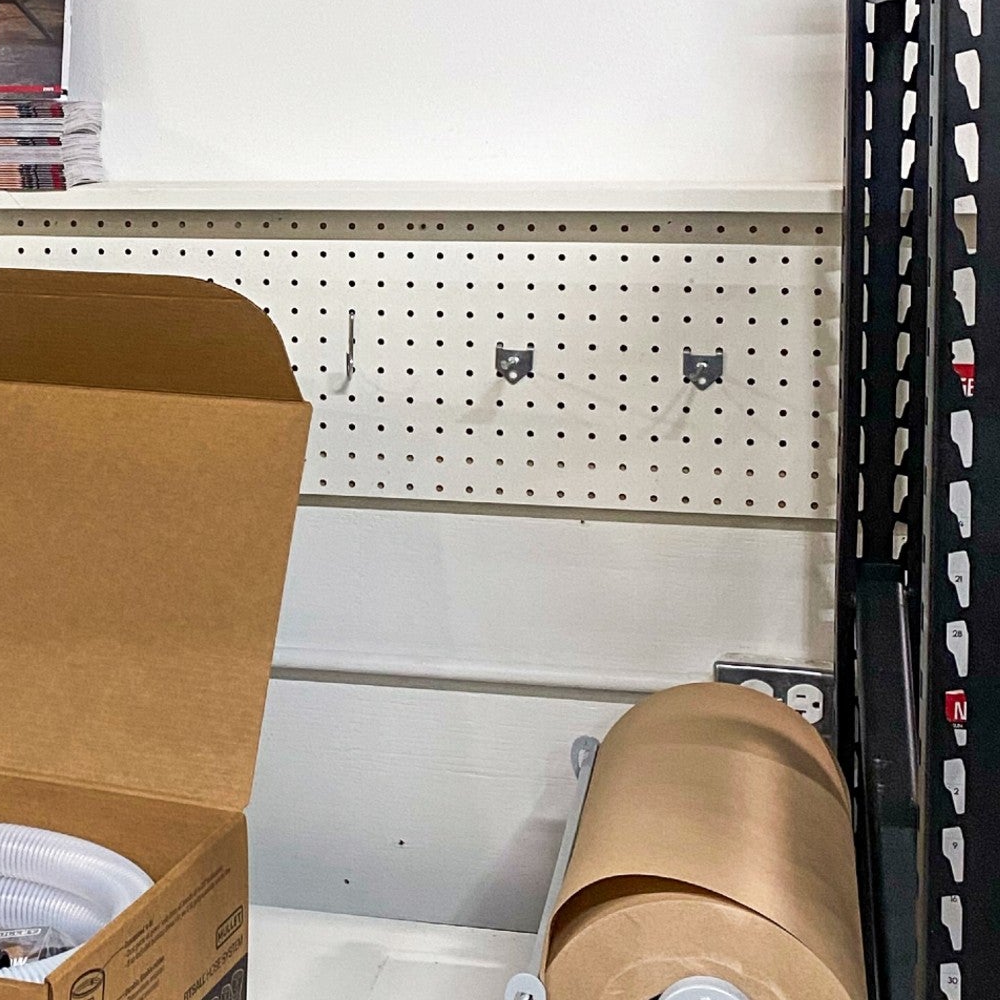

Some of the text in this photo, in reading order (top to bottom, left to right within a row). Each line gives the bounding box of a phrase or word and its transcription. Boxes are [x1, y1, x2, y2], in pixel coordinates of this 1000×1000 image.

[954, 575, 963, 583] 21
[952, 629, 963, 638] 28
[953, 787, 960, 796] 2
[947, 976, 958, 985] 30
